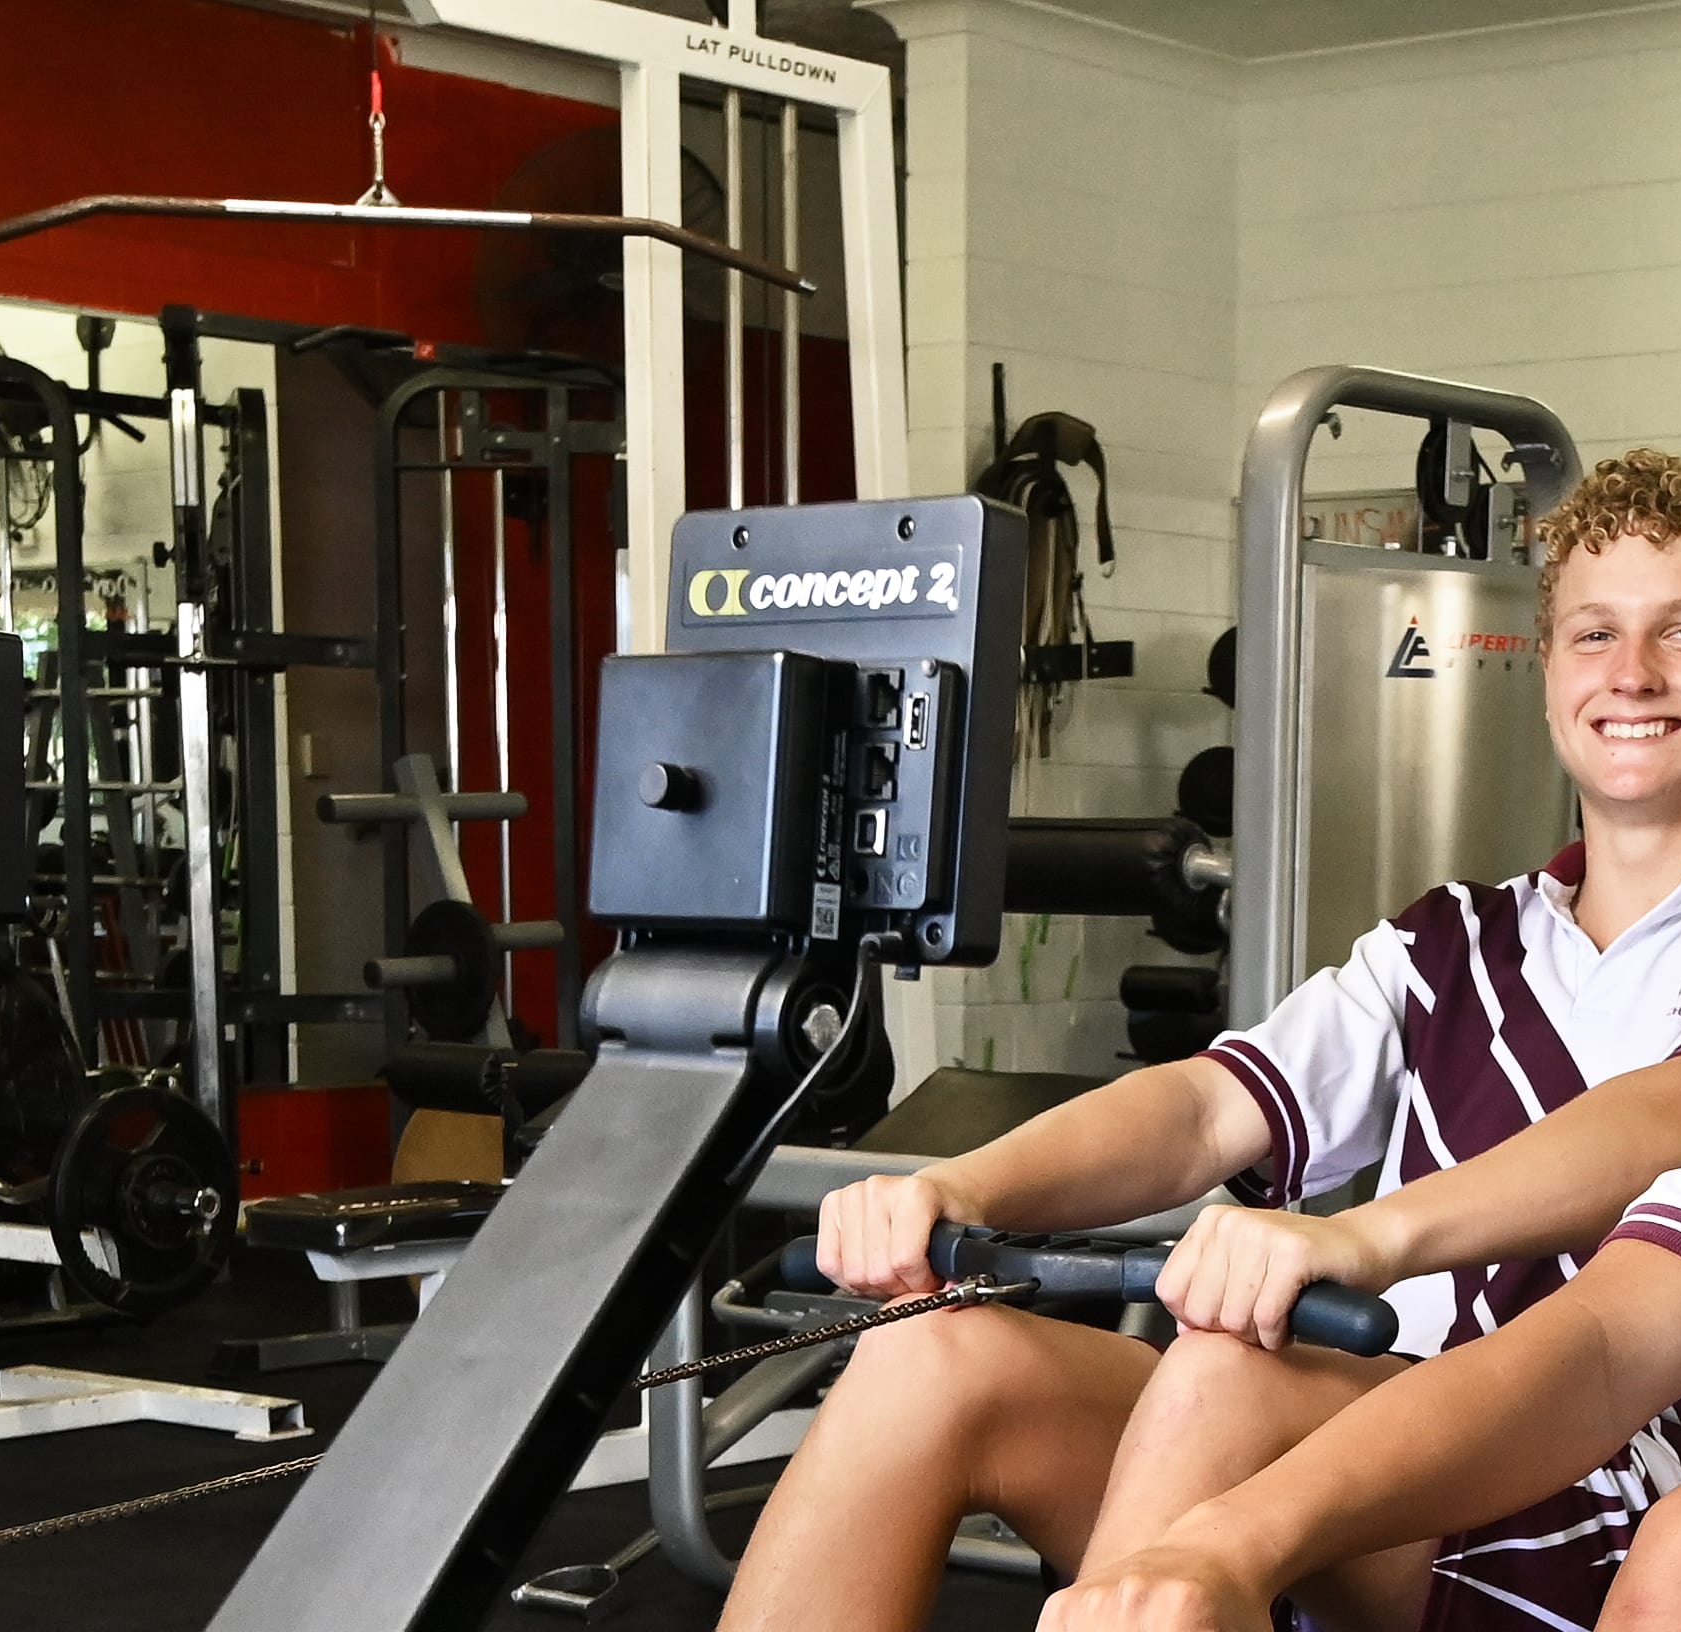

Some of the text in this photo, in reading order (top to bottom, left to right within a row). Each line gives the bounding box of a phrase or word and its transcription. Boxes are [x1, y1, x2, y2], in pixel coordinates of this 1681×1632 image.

[686, 35, 837, 84] LAT PULLDOWN
[749, 561, 958, 611] concept 2
